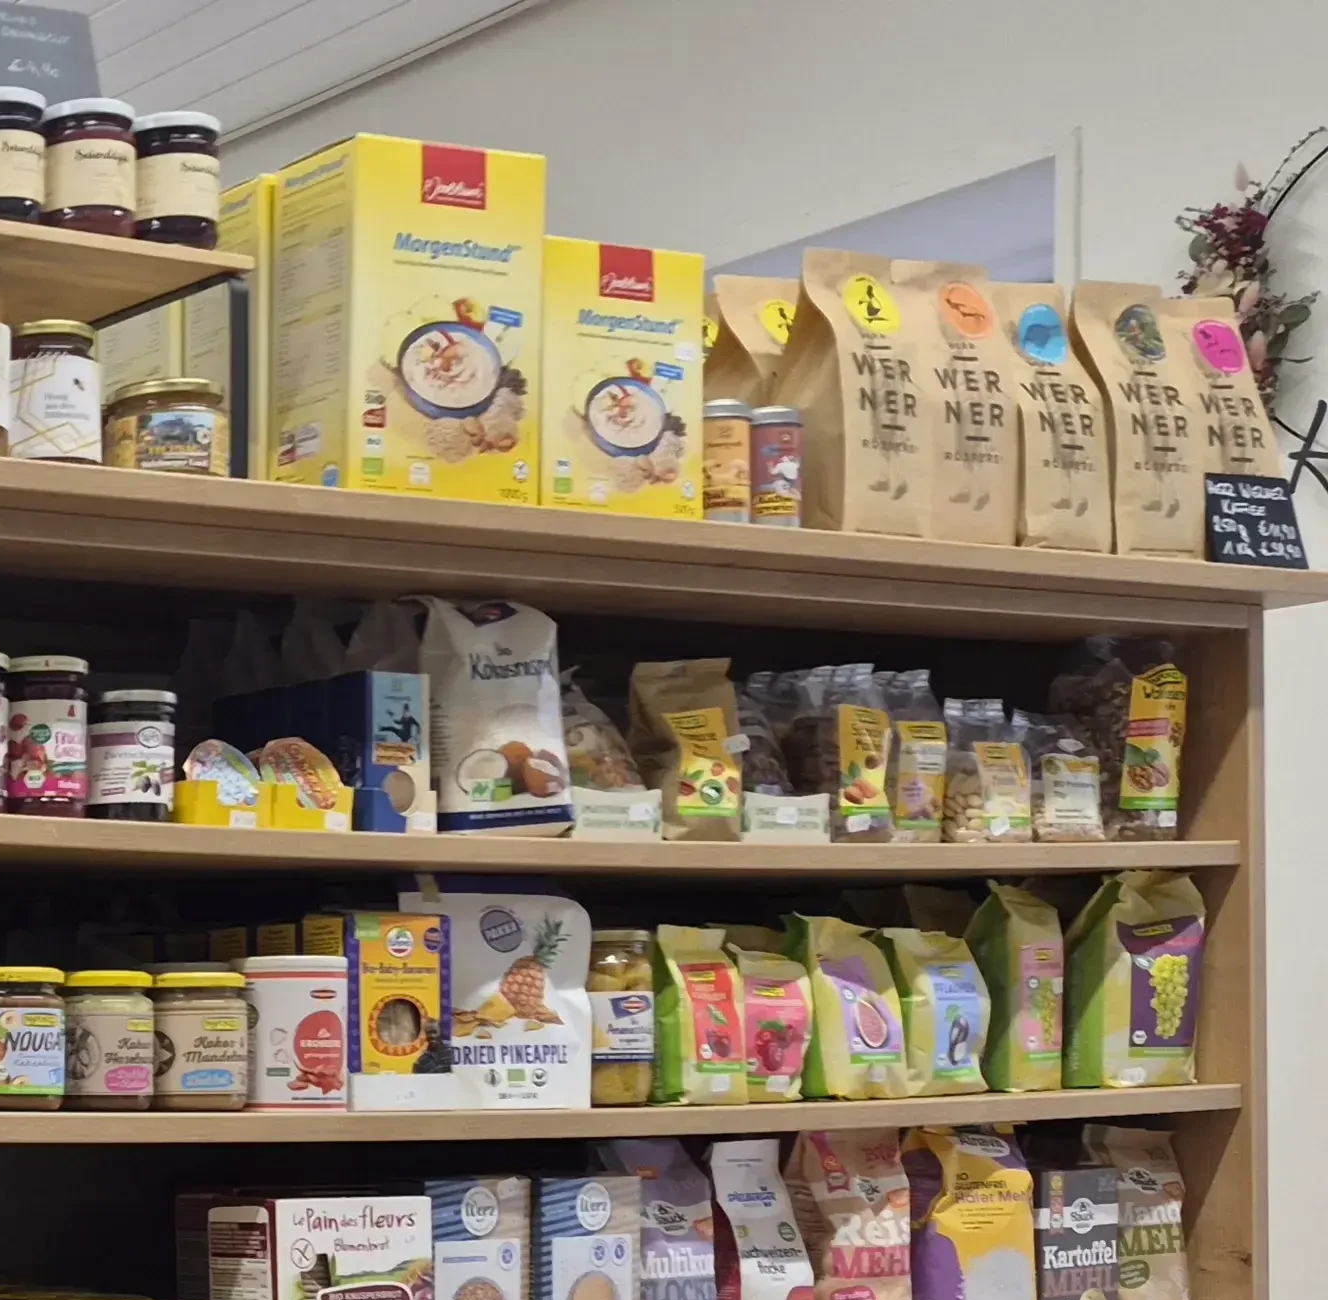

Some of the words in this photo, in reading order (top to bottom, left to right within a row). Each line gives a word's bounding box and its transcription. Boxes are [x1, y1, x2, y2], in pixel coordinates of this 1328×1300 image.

[852, 351, 913, 384] WER
[934, 366, 1001, 396] WER
[858, 387, 918, 419] NER
[1020, 381, 1090, 406] WER
[1118, 381, 1184, 408] WER
[945, 400, 1005, 428] NER
[1038, 411, 1095, 438] NER
[1131, 413, 1189, 440] NER
[453, 1044, 497, 1066] DRIED
[501, 1043, 568, 1066] PINEAPPLE
[304, 1207, 340, 1233] Pain
[360, 1205, 416, 1230] fleurs
[1043, 1240, 1118, 1269] Kartoffel
